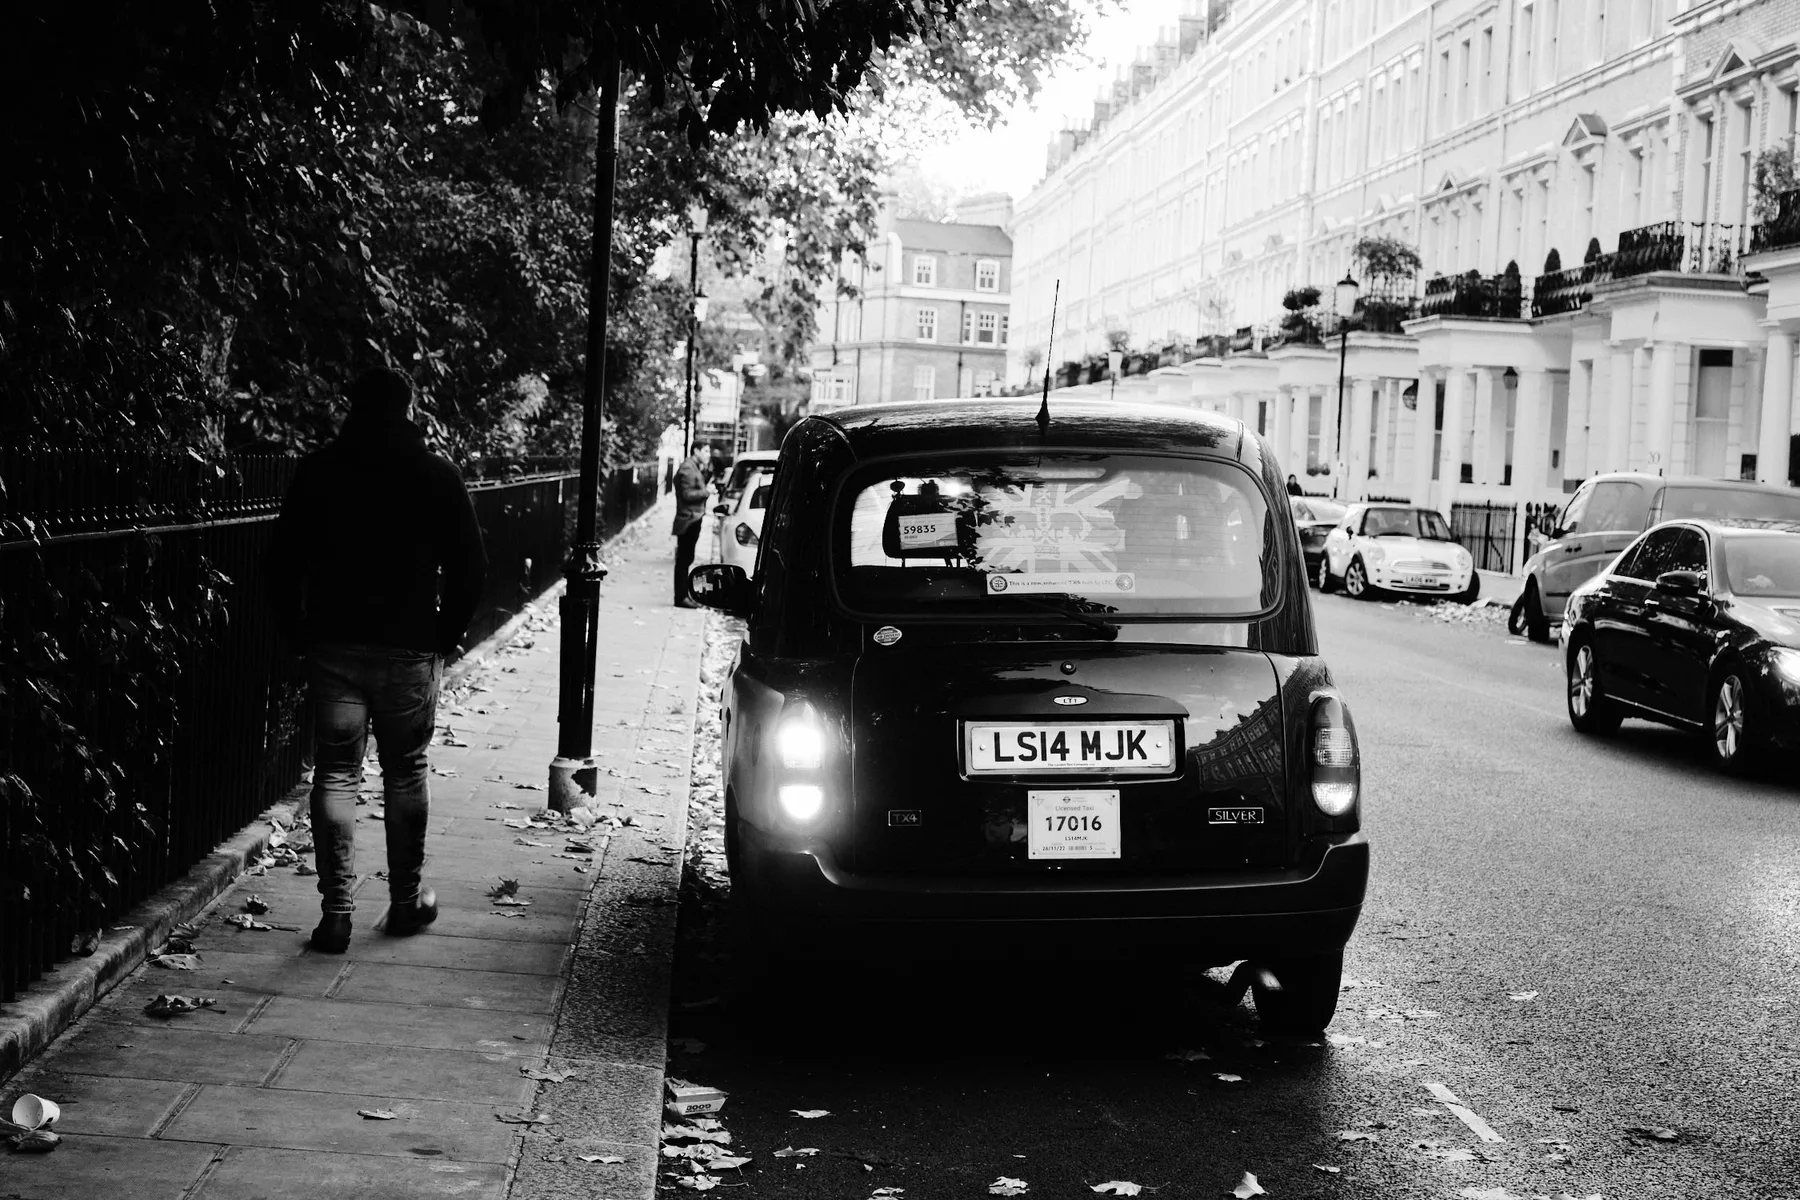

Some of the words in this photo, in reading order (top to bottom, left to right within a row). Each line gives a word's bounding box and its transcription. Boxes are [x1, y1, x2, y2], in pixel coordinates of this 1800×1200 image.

[903, 524, 936, 535] 59835
[993, 731, 1070, 762] LS14
[1080, 730, 1148, 761] MJK
[892, 813, 918, 823] TX4
[1215, 810, 1256, 821] SILVER
[1045, 815, 1102, 831] 17016
